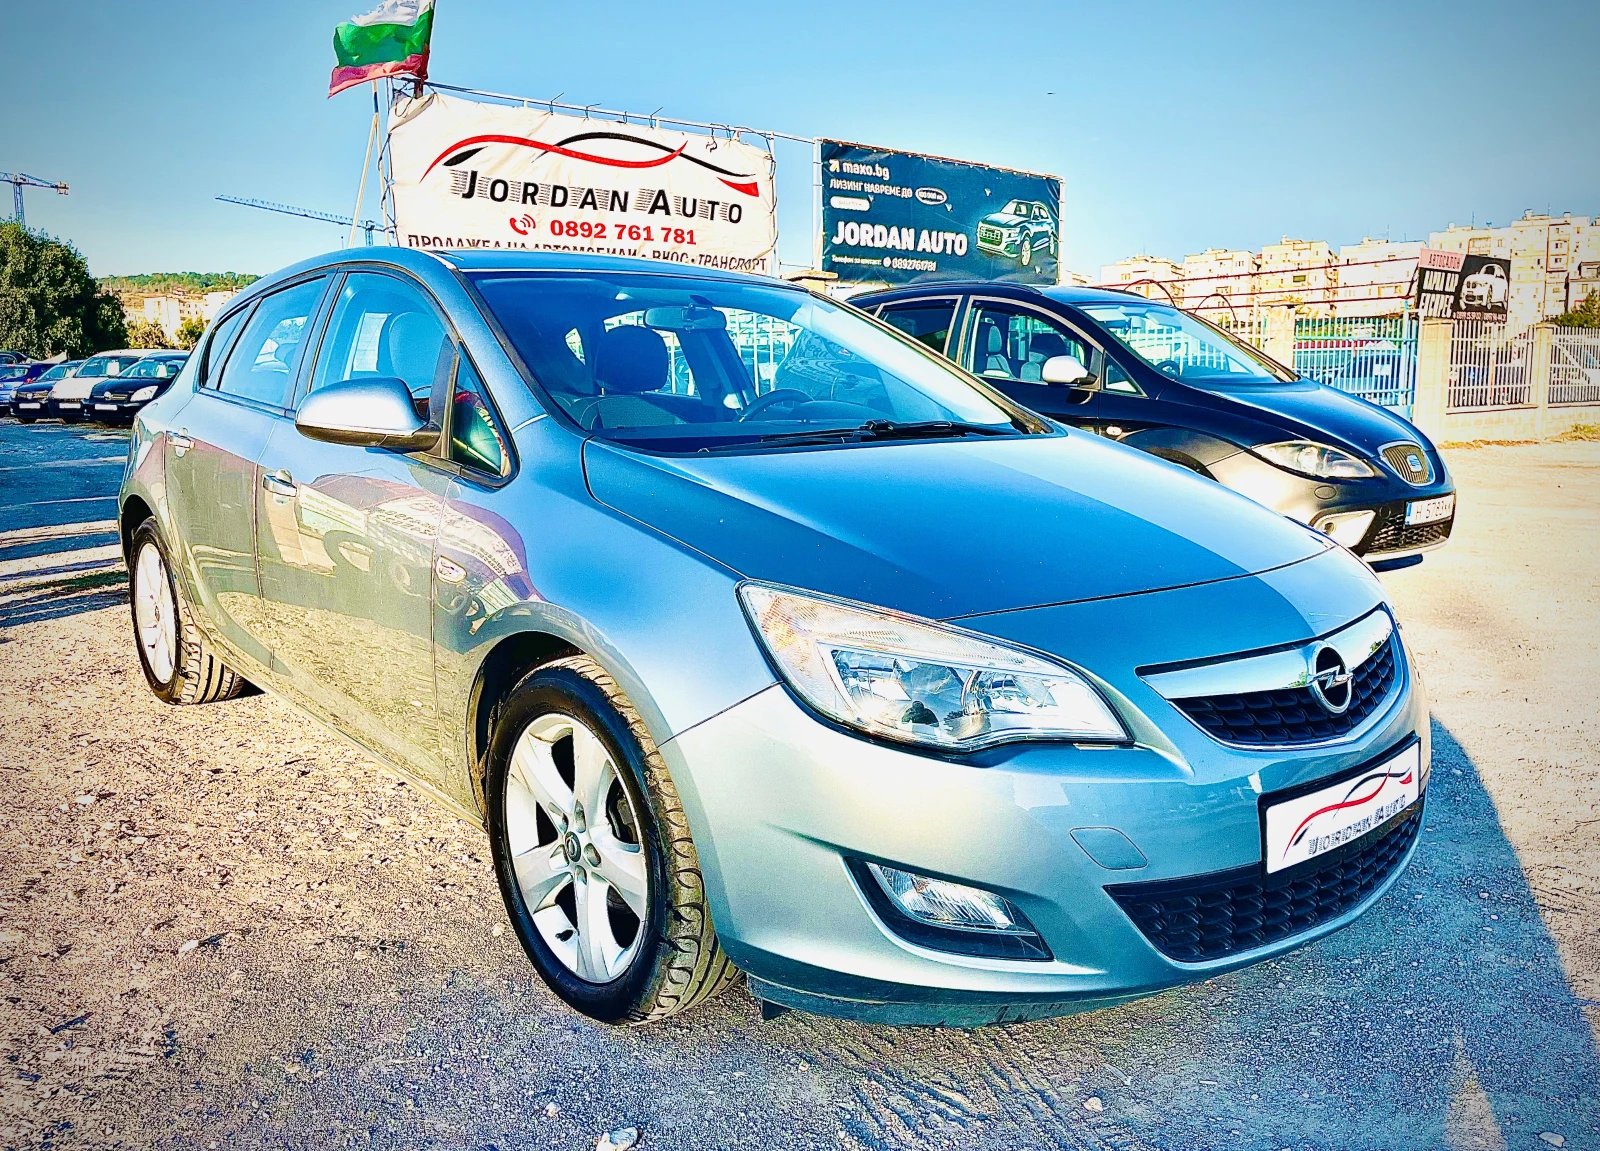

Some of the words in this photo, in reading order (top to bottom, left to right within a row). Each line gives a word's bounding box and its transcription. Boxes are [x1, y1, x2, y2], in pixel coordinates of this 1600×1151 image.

[842, 162, 890, 181] maxo.bg
[458, 169, 630, 213] JORDAN
[644, 188, 743, 224] AUTO
[829, 178, 863, 192] ЛИЗИНГ
[864, 181, 901, 197] НАВРЕМЕ
[901, 187, 914, 199] ДО
[550, 219, 607, 239] 0892
[614, 223, 654, 242] 761
[660, 226, 697, 245] 781
[831, 221, 915, 251] JORDAN
[917, 229, 968, 257] AUTO
[1309, 815, 1373, 855] JORDAN
[1373, 794, 1406, 824] AUTO
